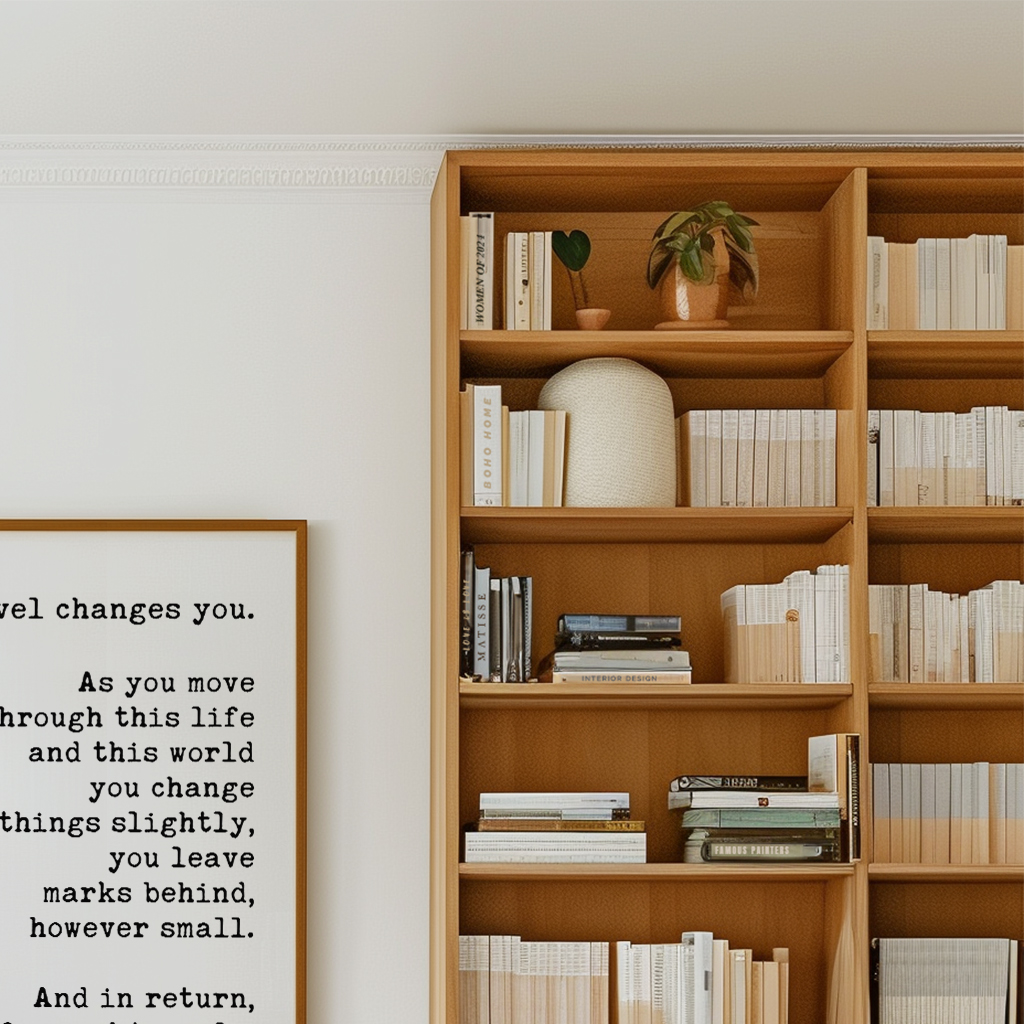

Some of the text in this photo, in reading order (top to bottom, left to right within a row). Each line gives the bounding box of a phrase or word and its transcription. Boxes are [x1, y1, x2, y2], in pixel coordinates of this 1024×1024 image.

[475, 234, 486, 323] WOMEN OF 2024
[483, 397, 492, 489] BOHO HOME
[57, 597, 180, 625] changes
[193, 603, 254, 625] you.
[477, 593, 487, 662] MATISSE
[79, 671, 254, 698] As you move
[115, 706, 179, 727] this
[192, 706, 254, 727] life
[29, 741, 254, 763] and this world
[89, 776, 254, 803] you change
[0, 811, 255, 838] things slightly,
[109, 846, 254, 873] you leave
[714, 845, 790, 855] FAMOUS PAINTERS
[44, 881, 255, 908] marks behind,
[30, 917, 254, 938] however small.
[34, 987, 255, 1013] And in return,
